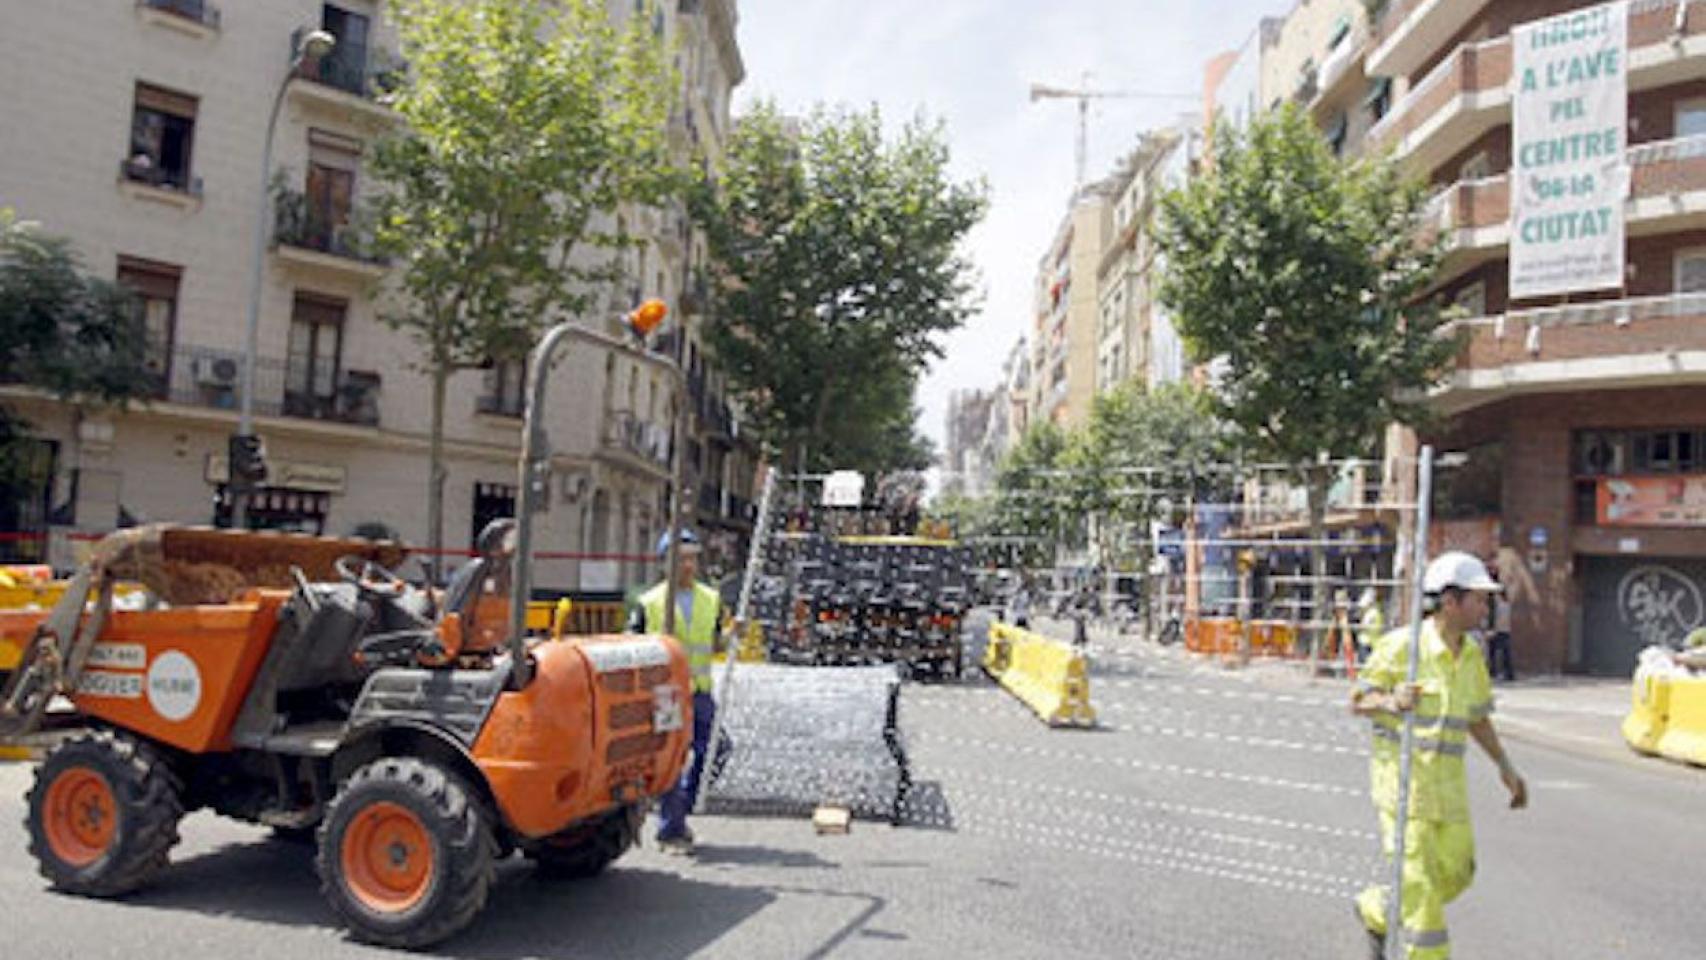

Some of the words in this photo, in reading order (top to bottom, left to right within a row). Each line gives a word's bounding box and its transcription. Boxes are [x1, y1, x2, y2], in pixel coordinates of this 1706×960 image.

[1520, 67, 1537, 92] A
[1546, 47, 1619, 87] L'AVE
[1519, 127, 1619, 169] CENTRE
[1519, 207, 1613, 244] CIUTAT
